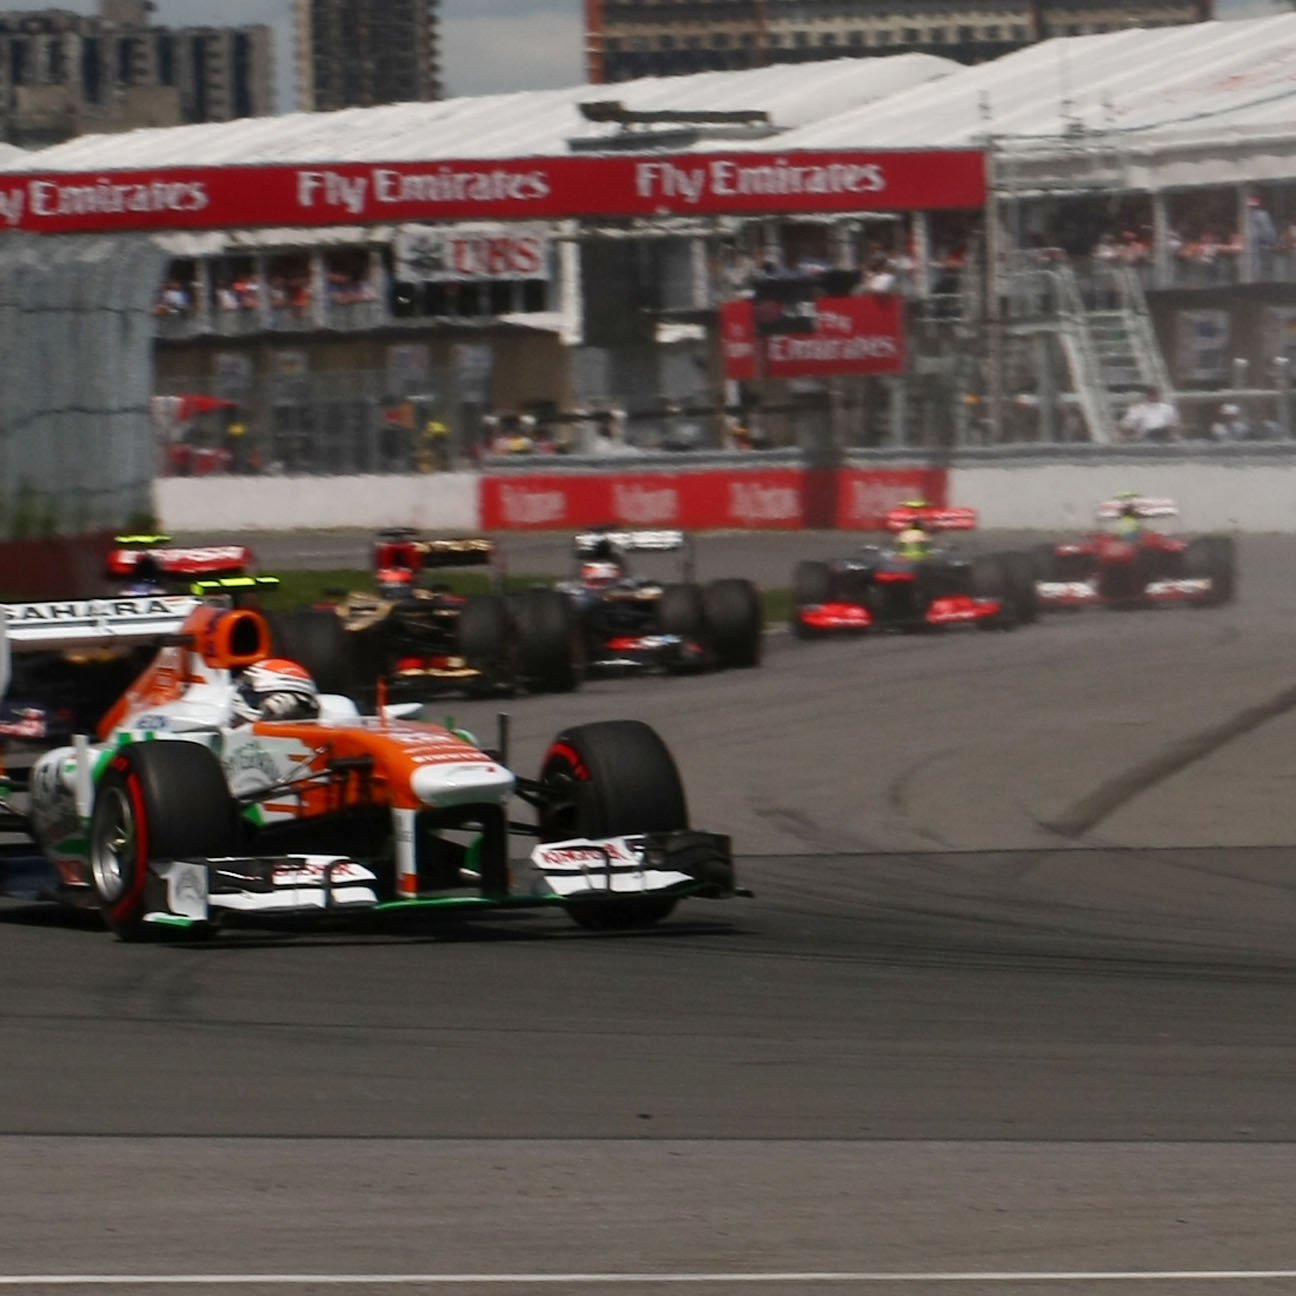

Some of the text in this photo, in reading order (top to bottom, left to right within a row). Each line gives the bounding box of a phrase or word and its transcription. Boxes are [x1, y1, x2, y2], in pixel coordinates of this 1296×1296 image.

[29, 177, 208, 216] Emirates
[297, 165, 551, 214] Fly Emirates
[635, 157, 886, 202] Fly Emirates
[451, 237, 541, 275] UBS
[767, 334, 897, 361] Emirates
